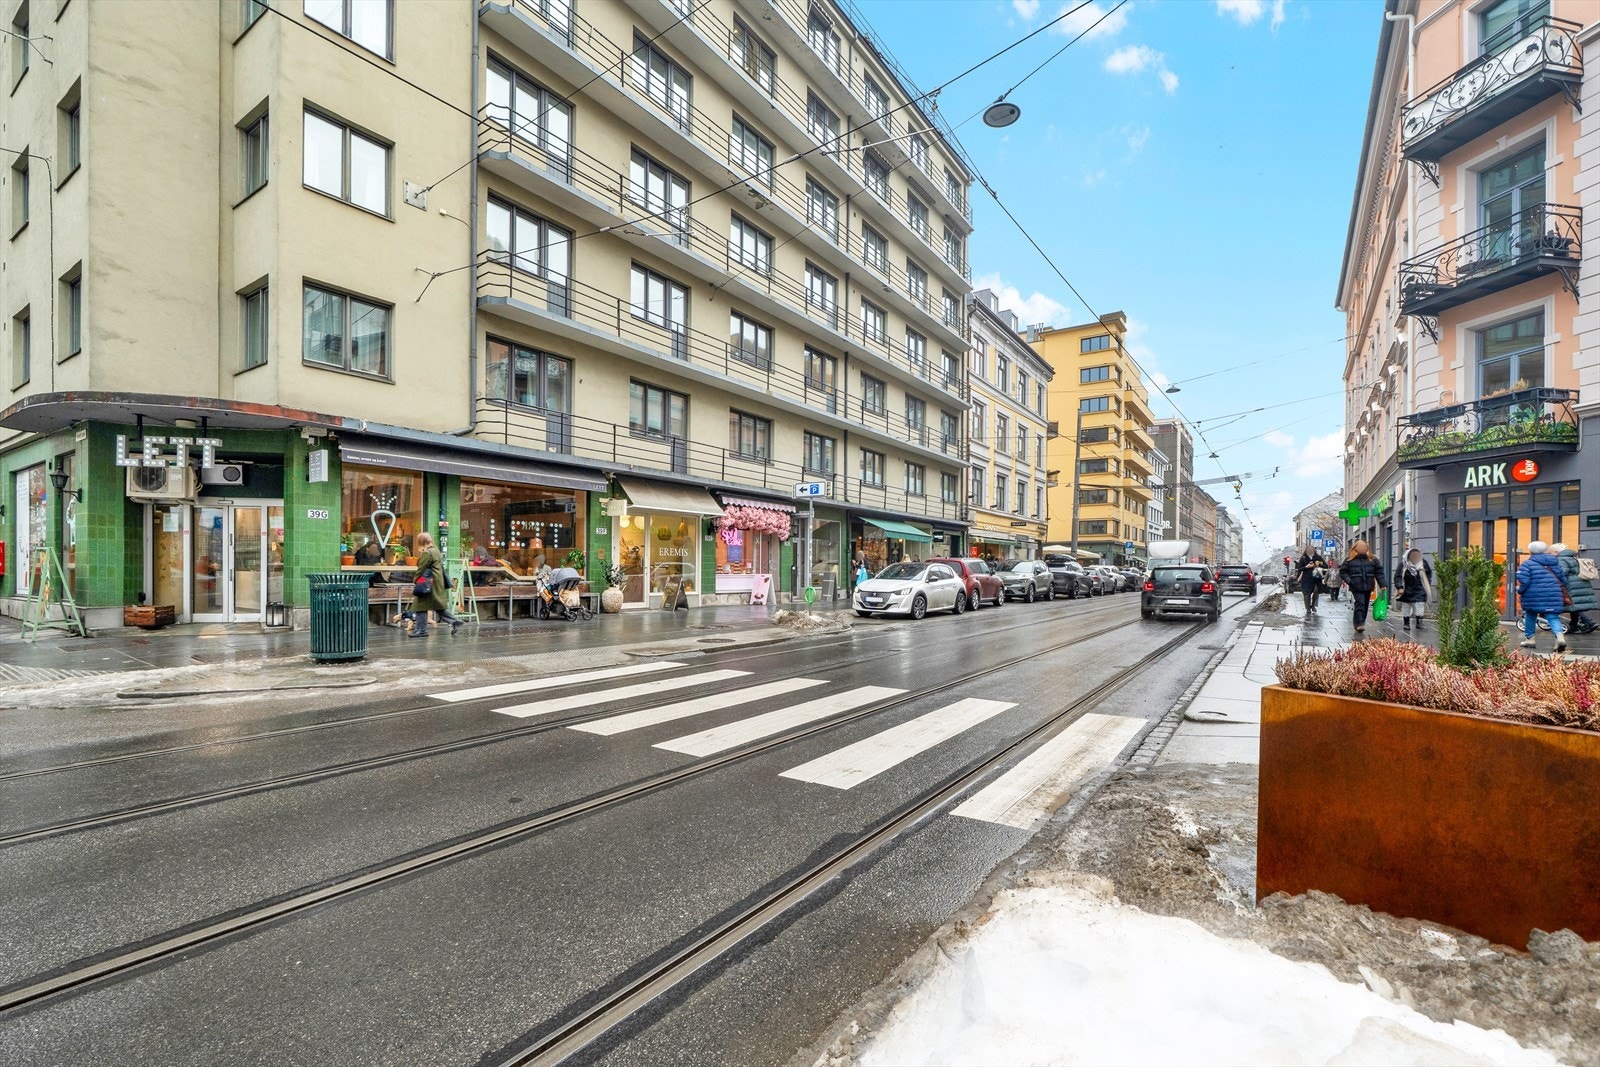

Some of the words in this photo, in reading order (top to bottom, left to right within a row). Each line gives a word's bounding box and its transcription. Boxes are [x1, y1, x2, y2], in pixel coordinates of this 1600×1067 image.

[116, 434, 223, 469] LETT
[1464, 462, 1507, 489] ARK
[310, 510, 328, 519] 39G
[490, 518, 563, 549] LETT
[1313, 531, 1321, 539] P
[659, 547, 689, 557] EREMIS
